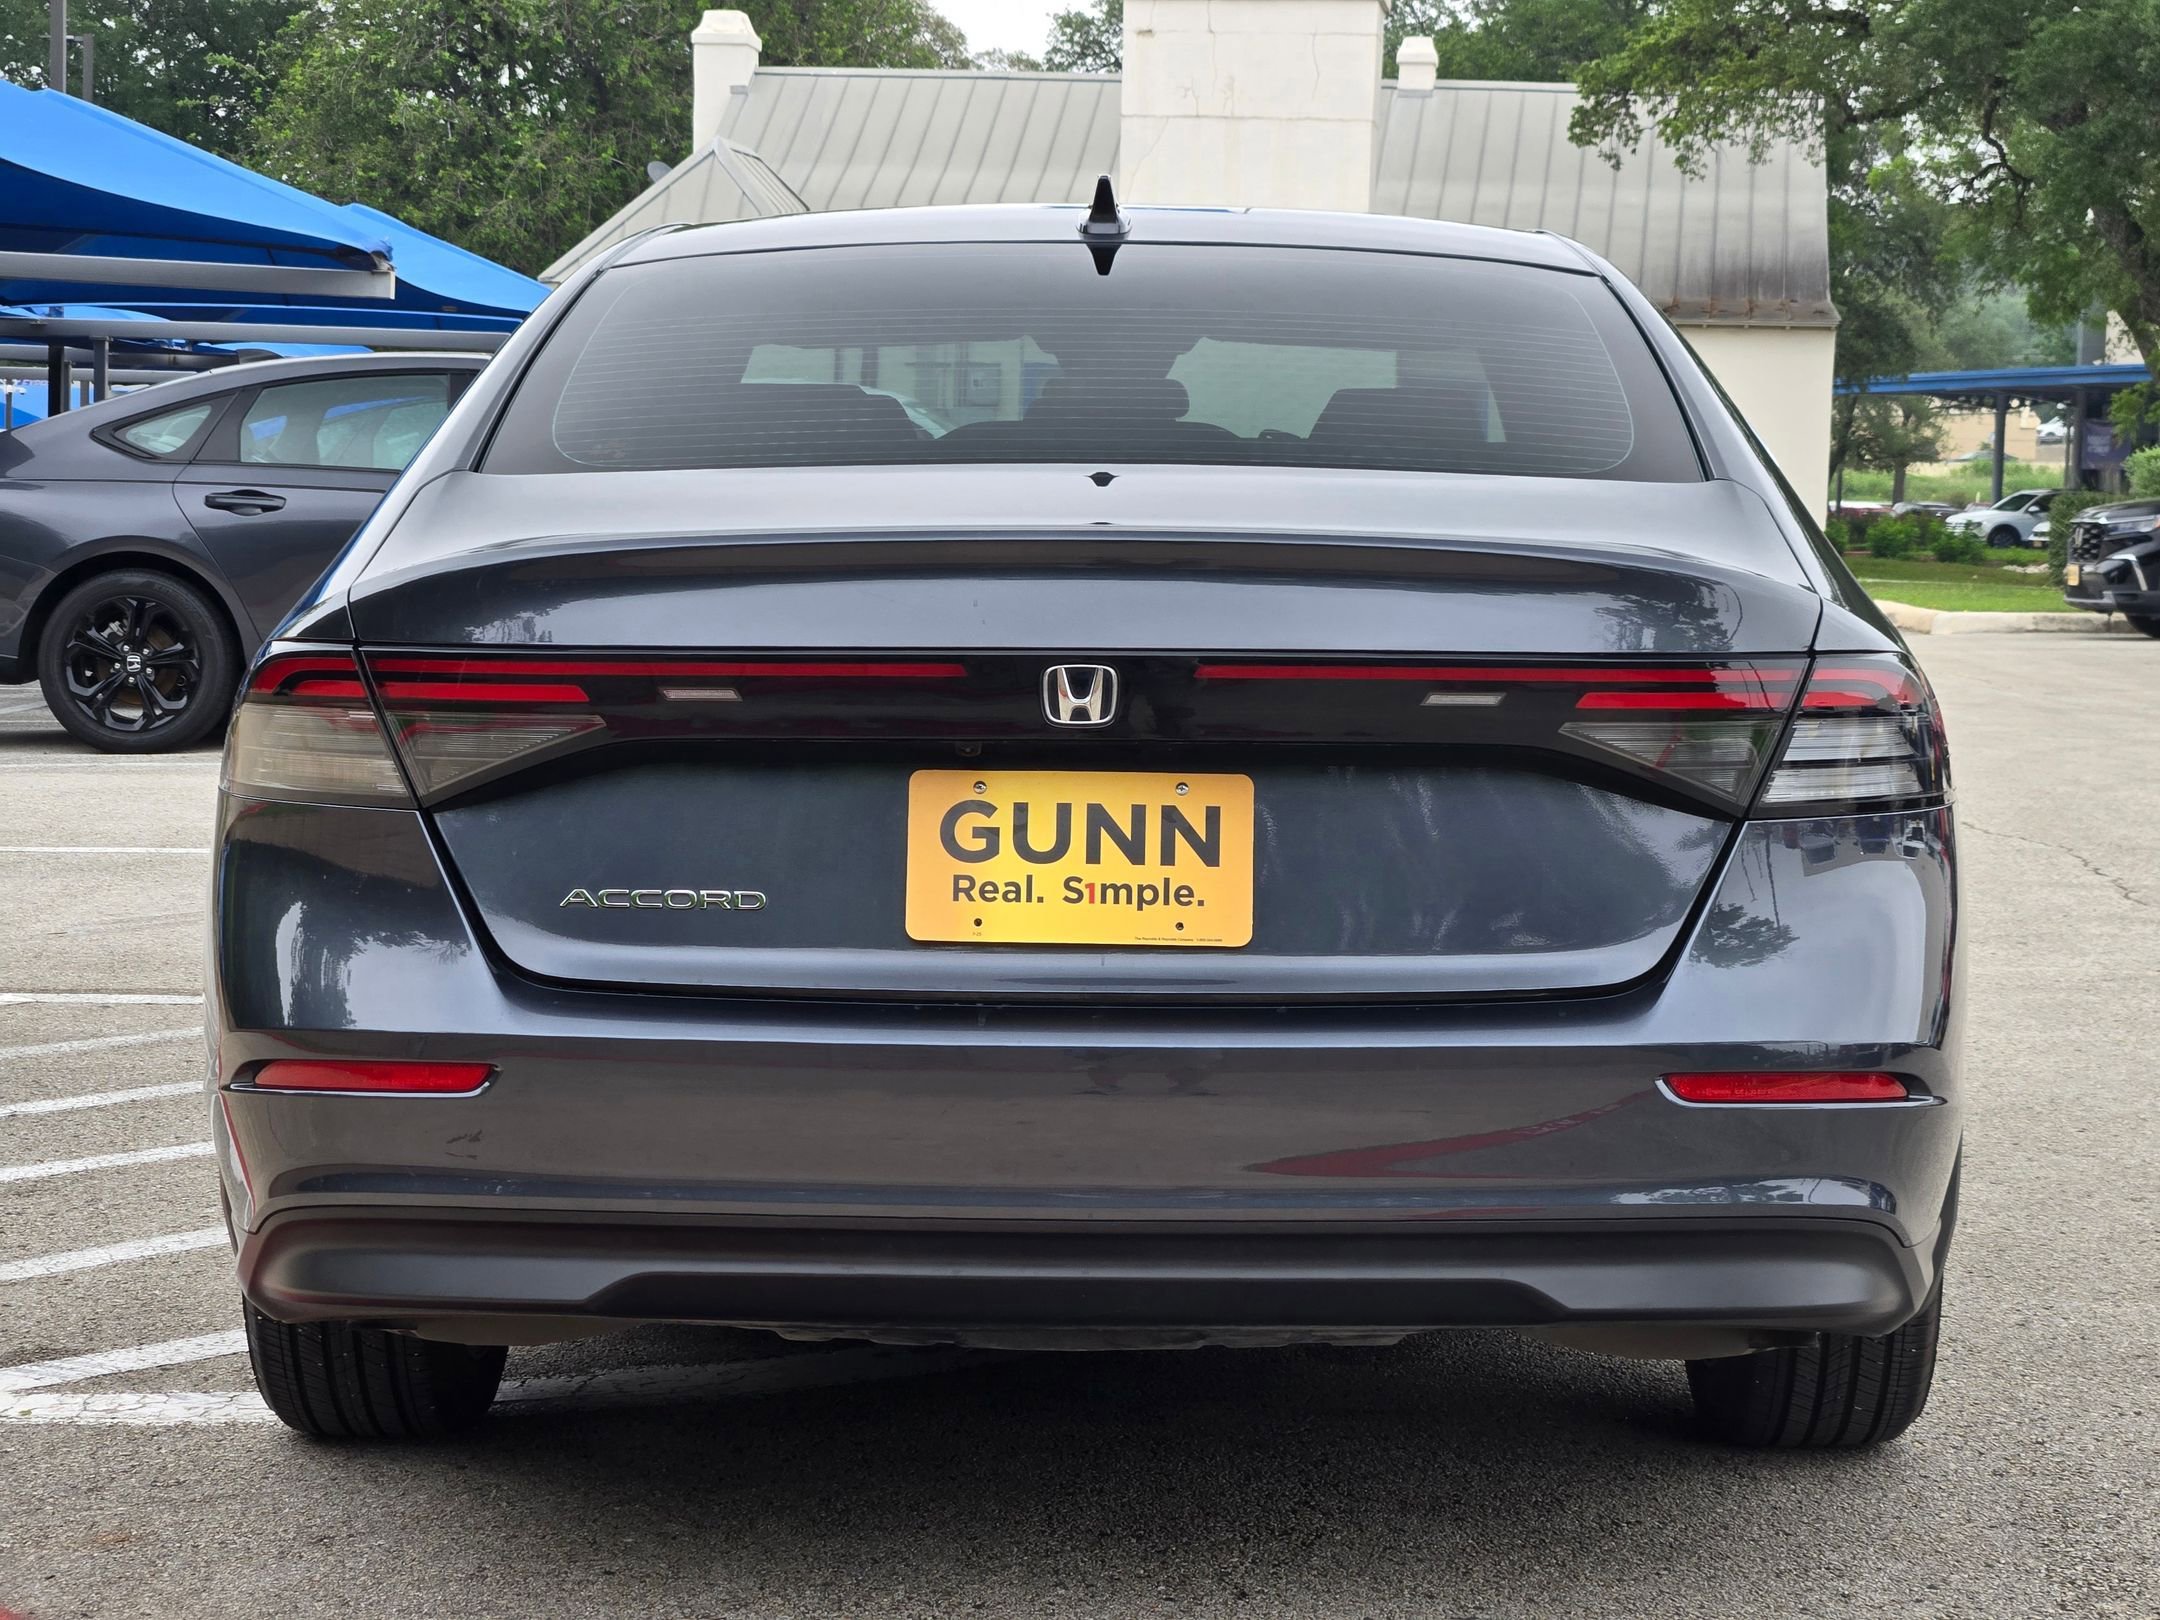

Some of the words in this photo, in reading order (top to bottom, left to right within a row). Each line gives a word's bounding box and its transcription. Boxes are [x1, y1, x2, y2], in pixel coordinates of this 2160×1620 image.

[940, 800, 1221, 867] GUNN
[560, 888, 766, 910] ACCORD
[952, 874, 1044, 903] Real.
[1062, 876, 1205, 911] S1mple.
